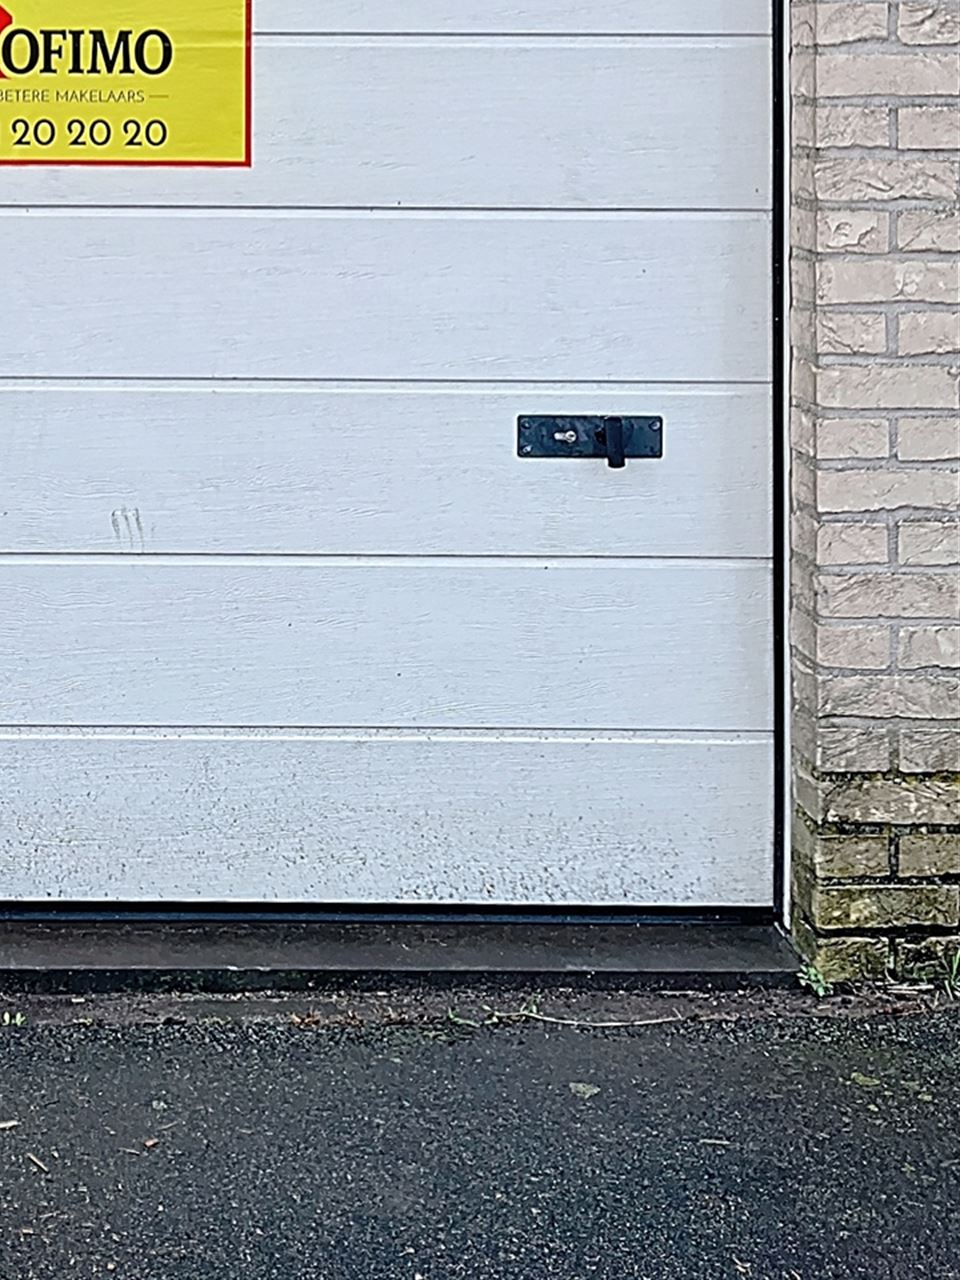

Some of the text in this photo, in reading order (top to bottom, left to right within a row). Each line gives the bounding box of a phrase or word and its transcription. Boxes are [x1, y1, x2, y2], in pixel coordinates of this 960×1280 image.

[55, 89, 145, 103] MAKELAARS
[11, 119, 56, 146] 20
[67, 119, 112, 146] 20
[124, 119, 168, 147] 20
